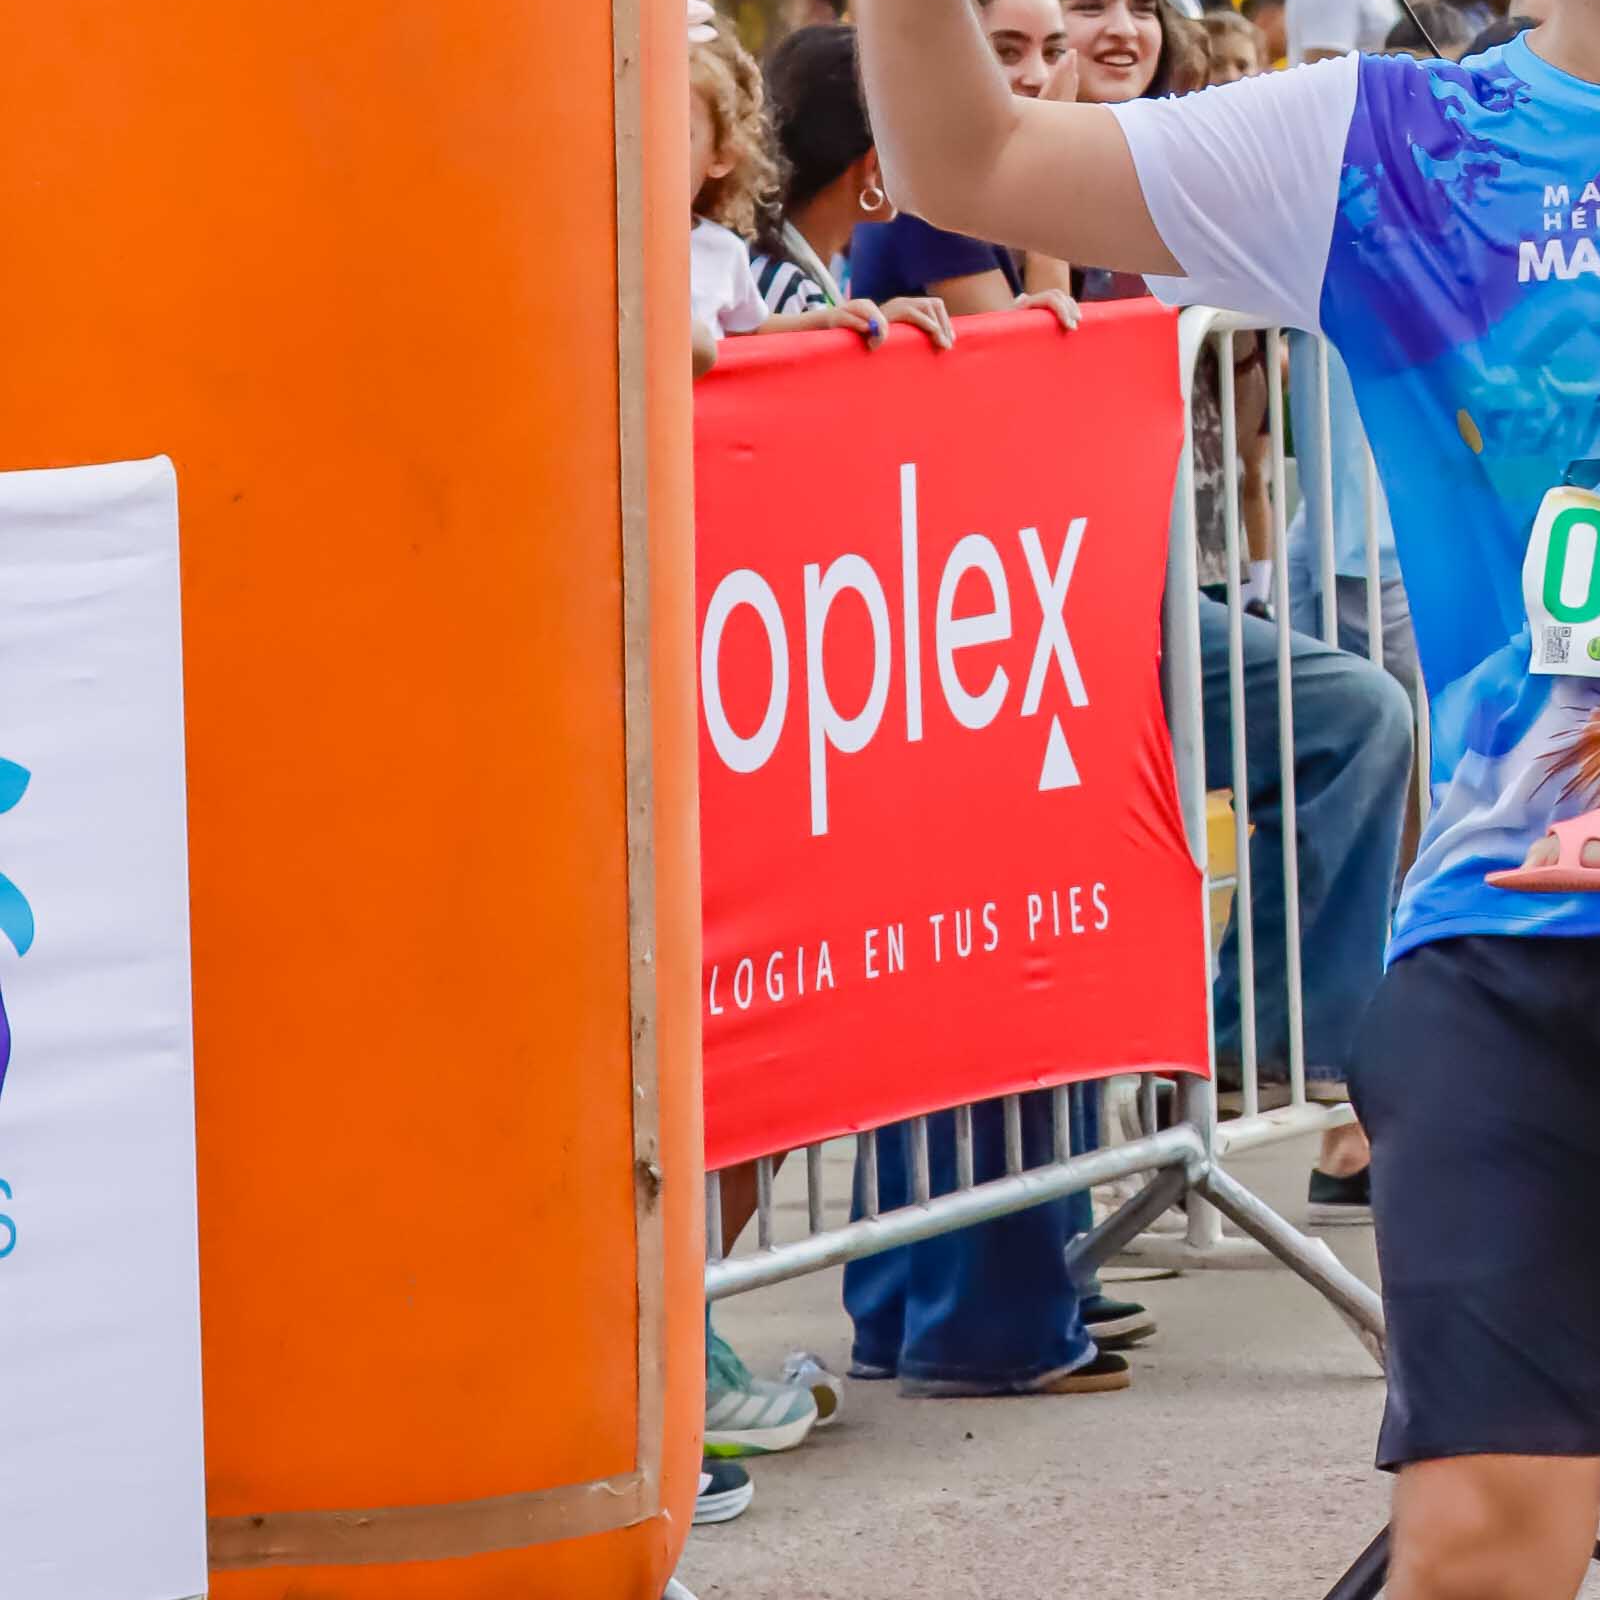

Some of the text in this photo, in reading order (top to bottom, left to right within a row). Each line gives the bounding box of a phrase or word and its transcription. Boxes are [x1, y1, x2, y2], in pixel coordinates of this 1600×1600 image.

[700, 462, 1089, 836] oplex
[709, 882, 1109, 1015] LOGIA EN TUS PIES
